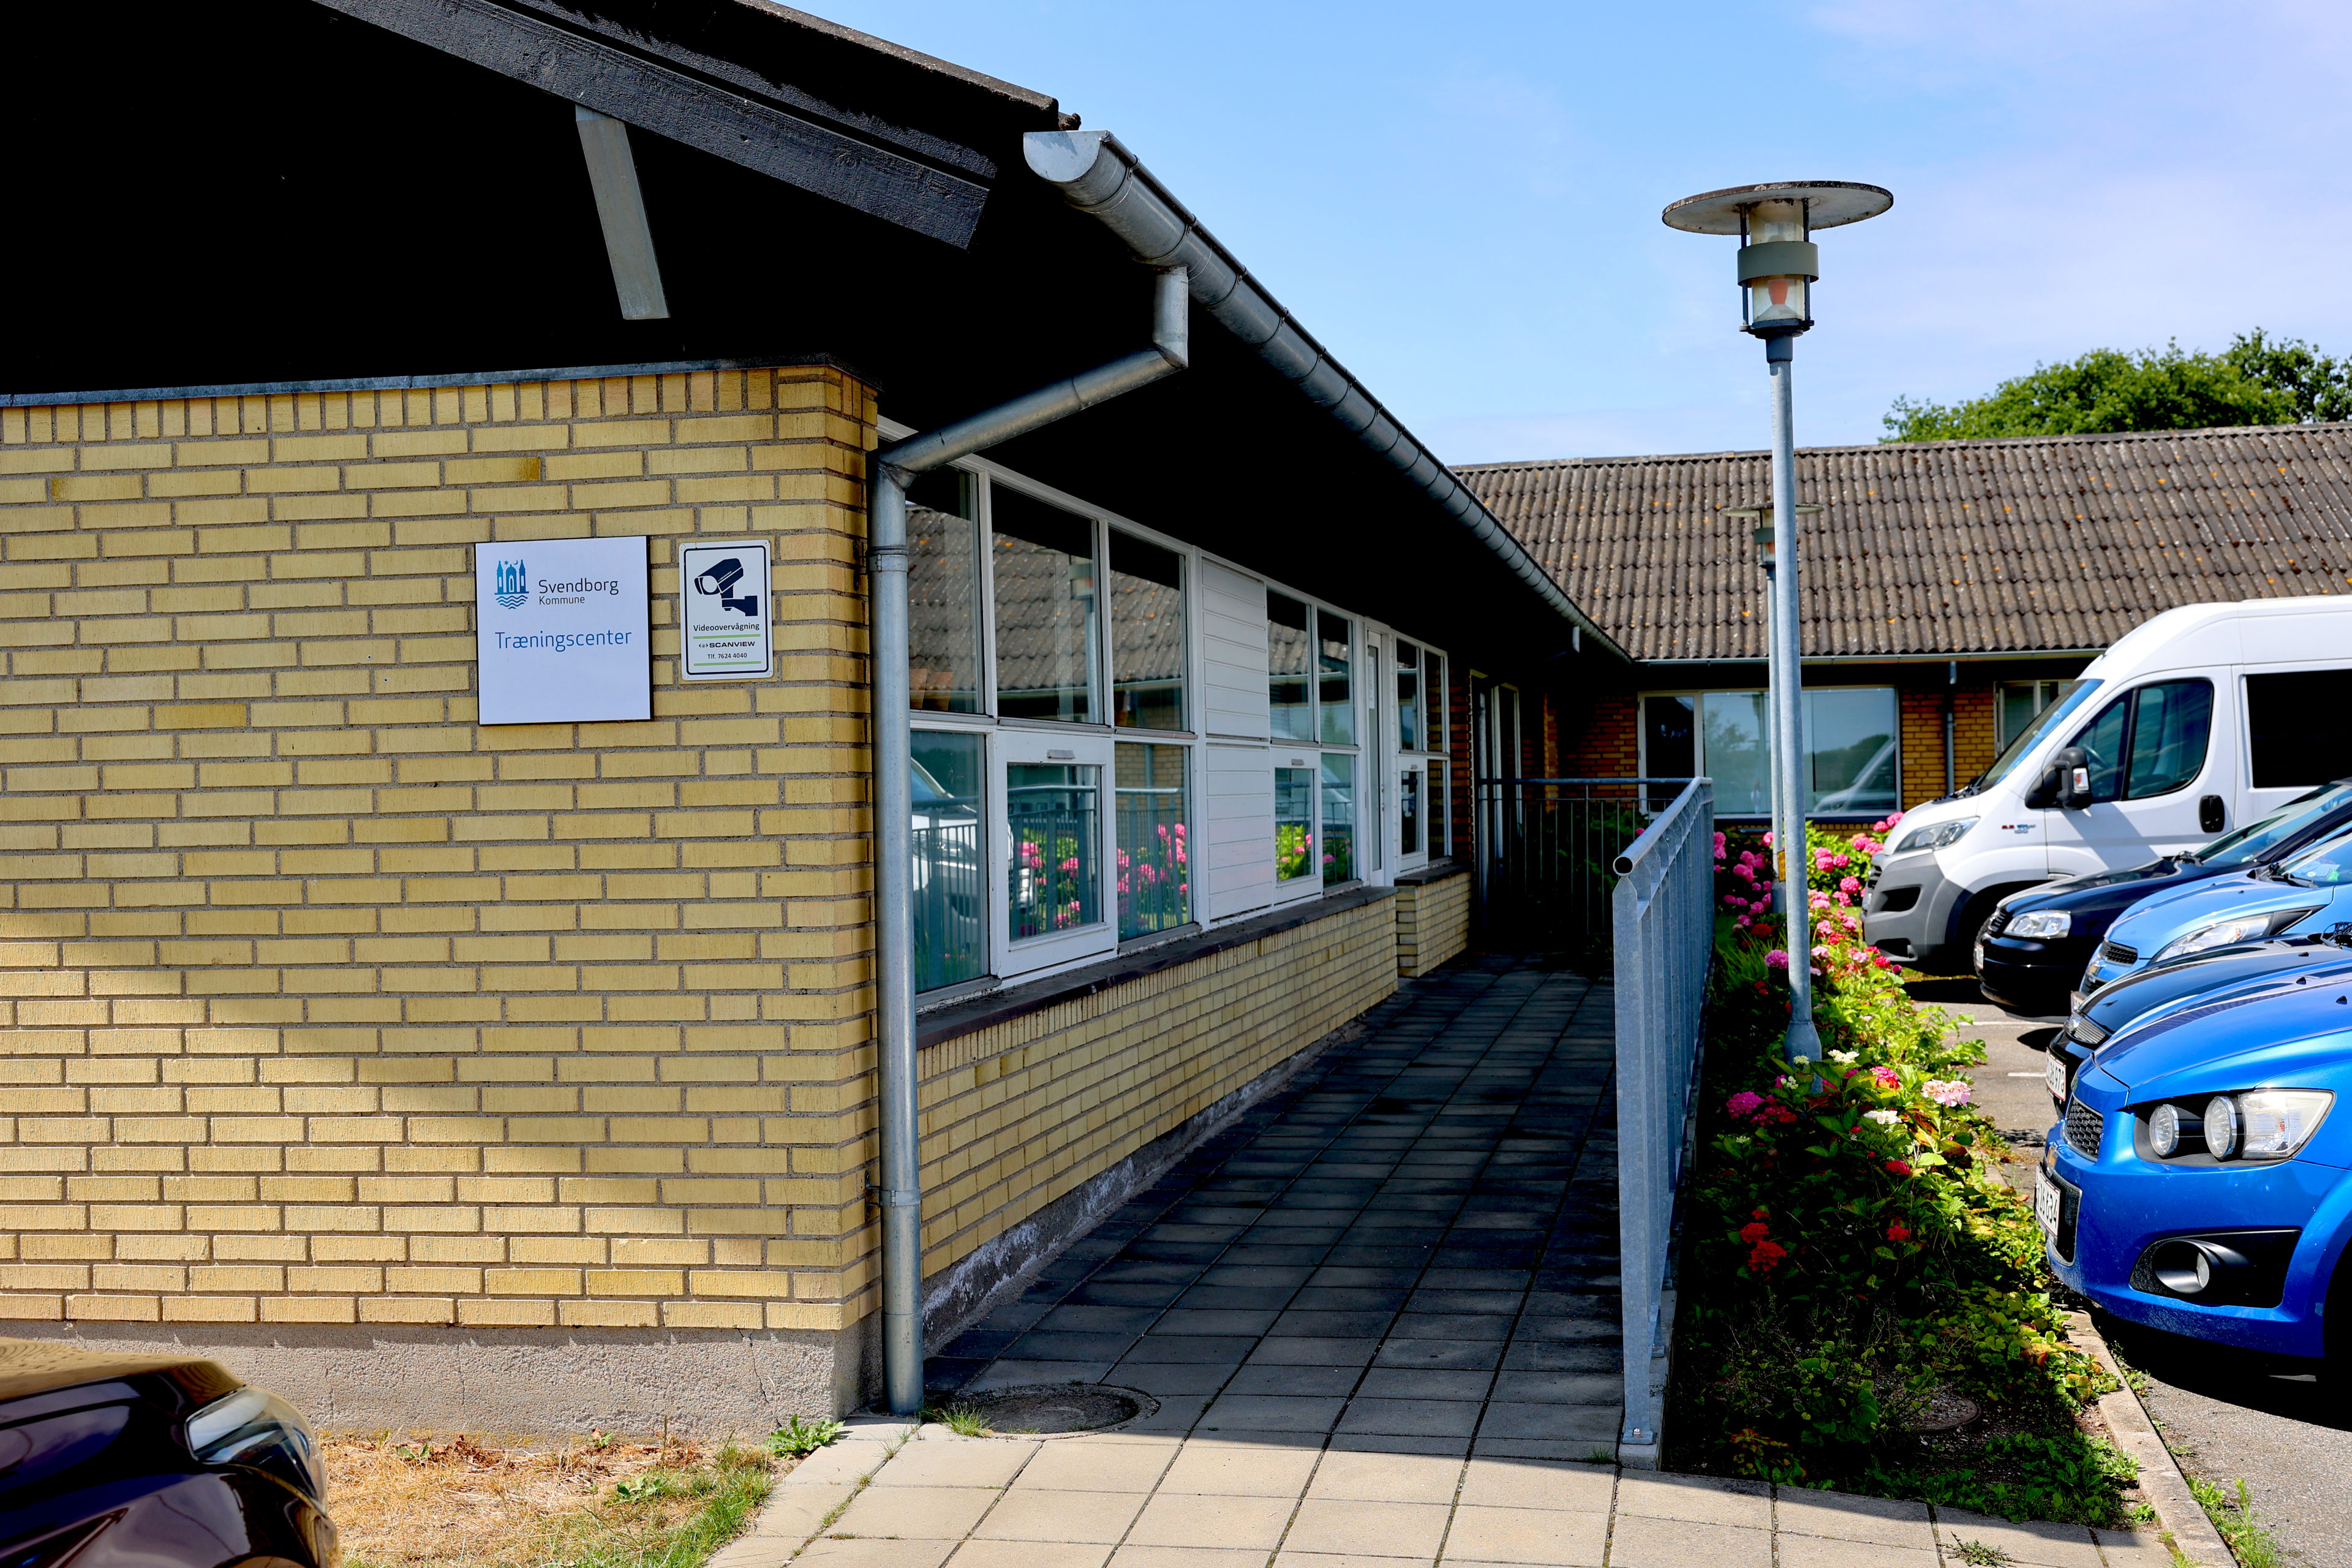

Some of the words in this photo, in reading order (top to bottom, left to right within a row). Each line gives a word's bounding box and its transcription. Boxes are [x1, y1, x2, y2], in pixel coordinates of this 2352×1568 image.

[538, 578, 619, 595] Svendborg
[539, 596, 585, 605] Kommune
[693, 622, 760, 631] Videoovervågning
[495, 630, 632, 652] Træningscenter
